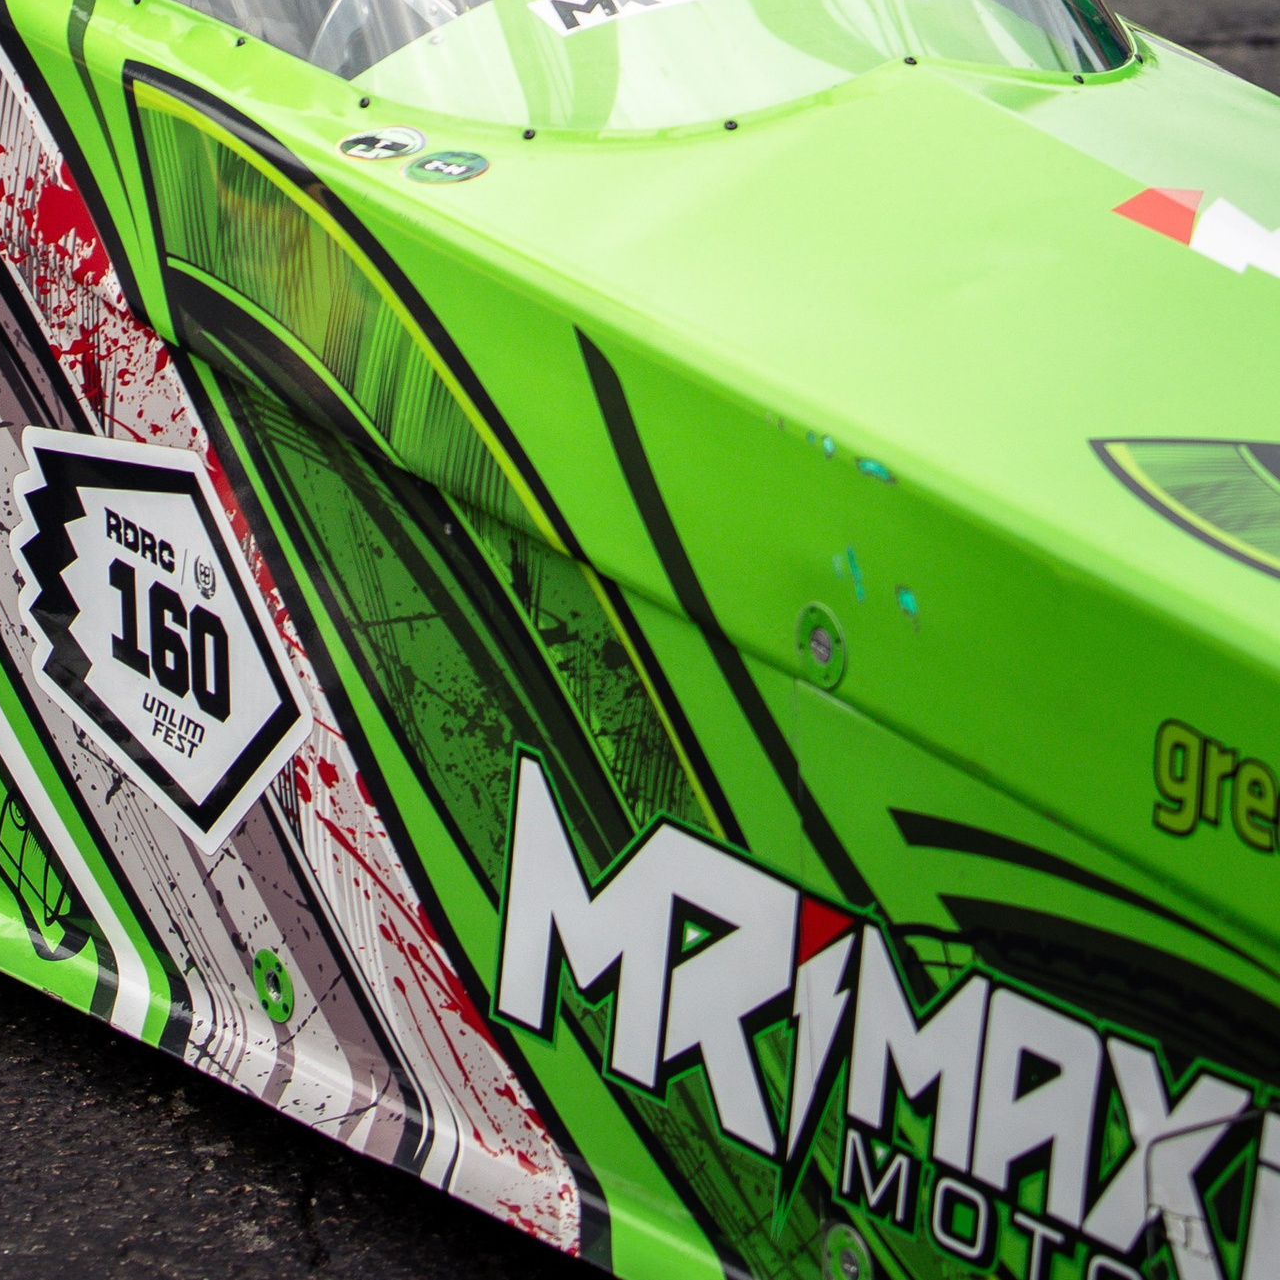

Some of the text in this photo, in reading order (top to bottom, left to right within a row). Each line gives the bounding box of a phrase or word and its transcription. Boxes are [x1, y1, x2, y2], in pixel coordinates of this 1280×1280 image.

[104, 506, 175, 574] RDRC
[108, 557, 231, 723] 160
[151, 717, 200, 759] FEST
[847, 924, 1280, 1280] MAX
[841, 1129, 1144, 1280] MOT
